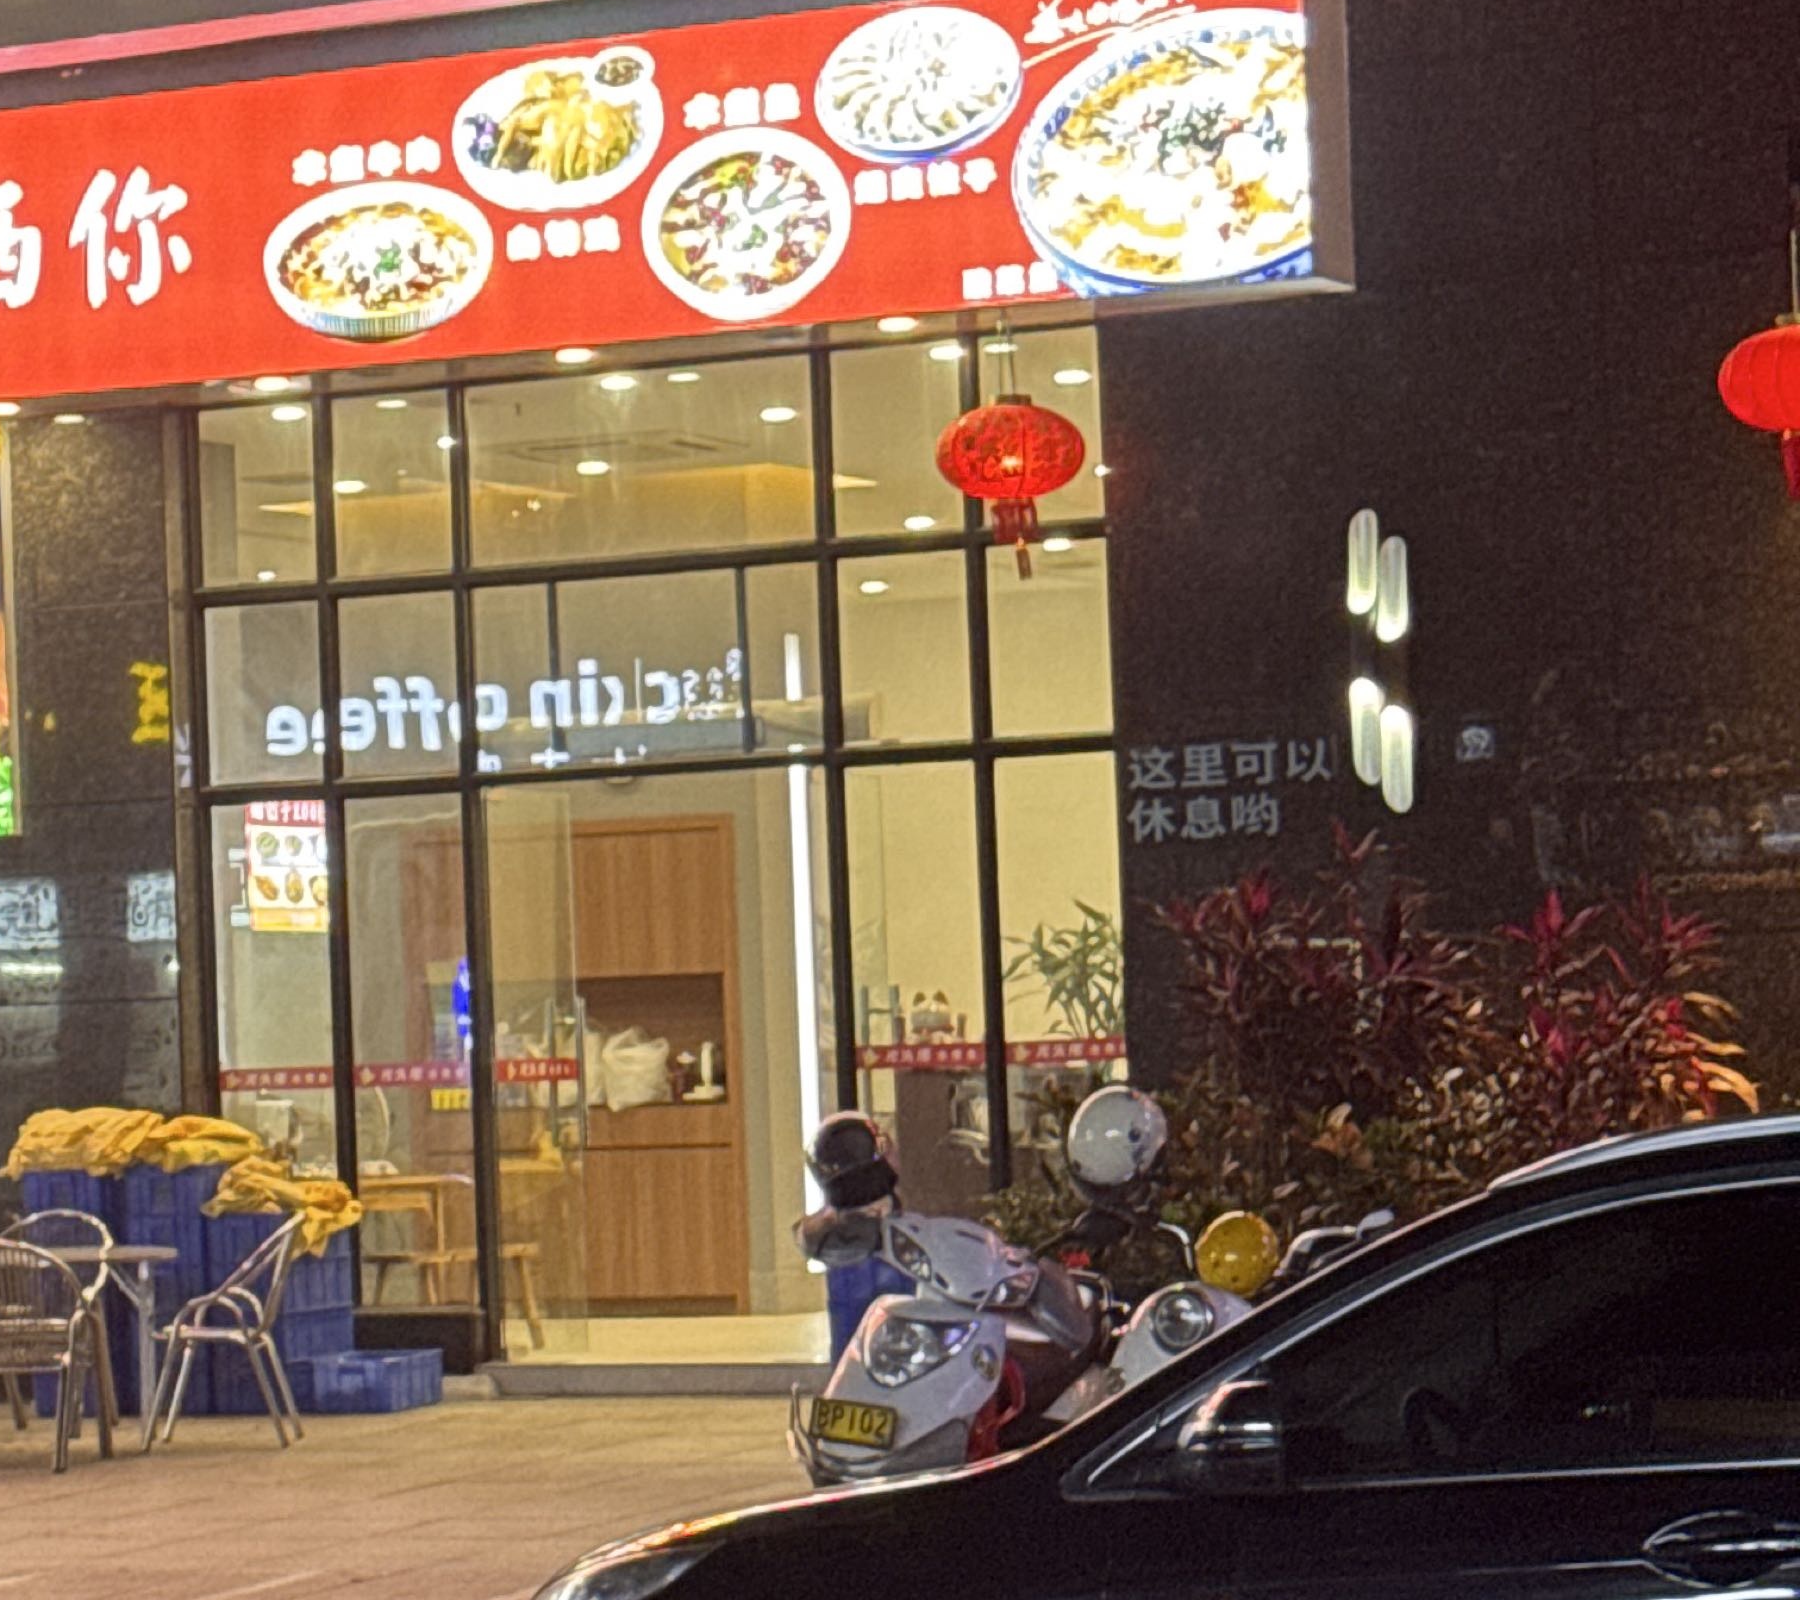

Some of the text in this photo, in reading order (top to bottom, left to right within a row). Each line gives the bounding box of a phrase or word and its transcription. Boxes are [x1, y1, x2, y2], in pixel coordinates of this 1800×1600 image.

[1128, 739, 1332, 791] 这里可以
[1127, 793, 1280, 844] 休息哟
